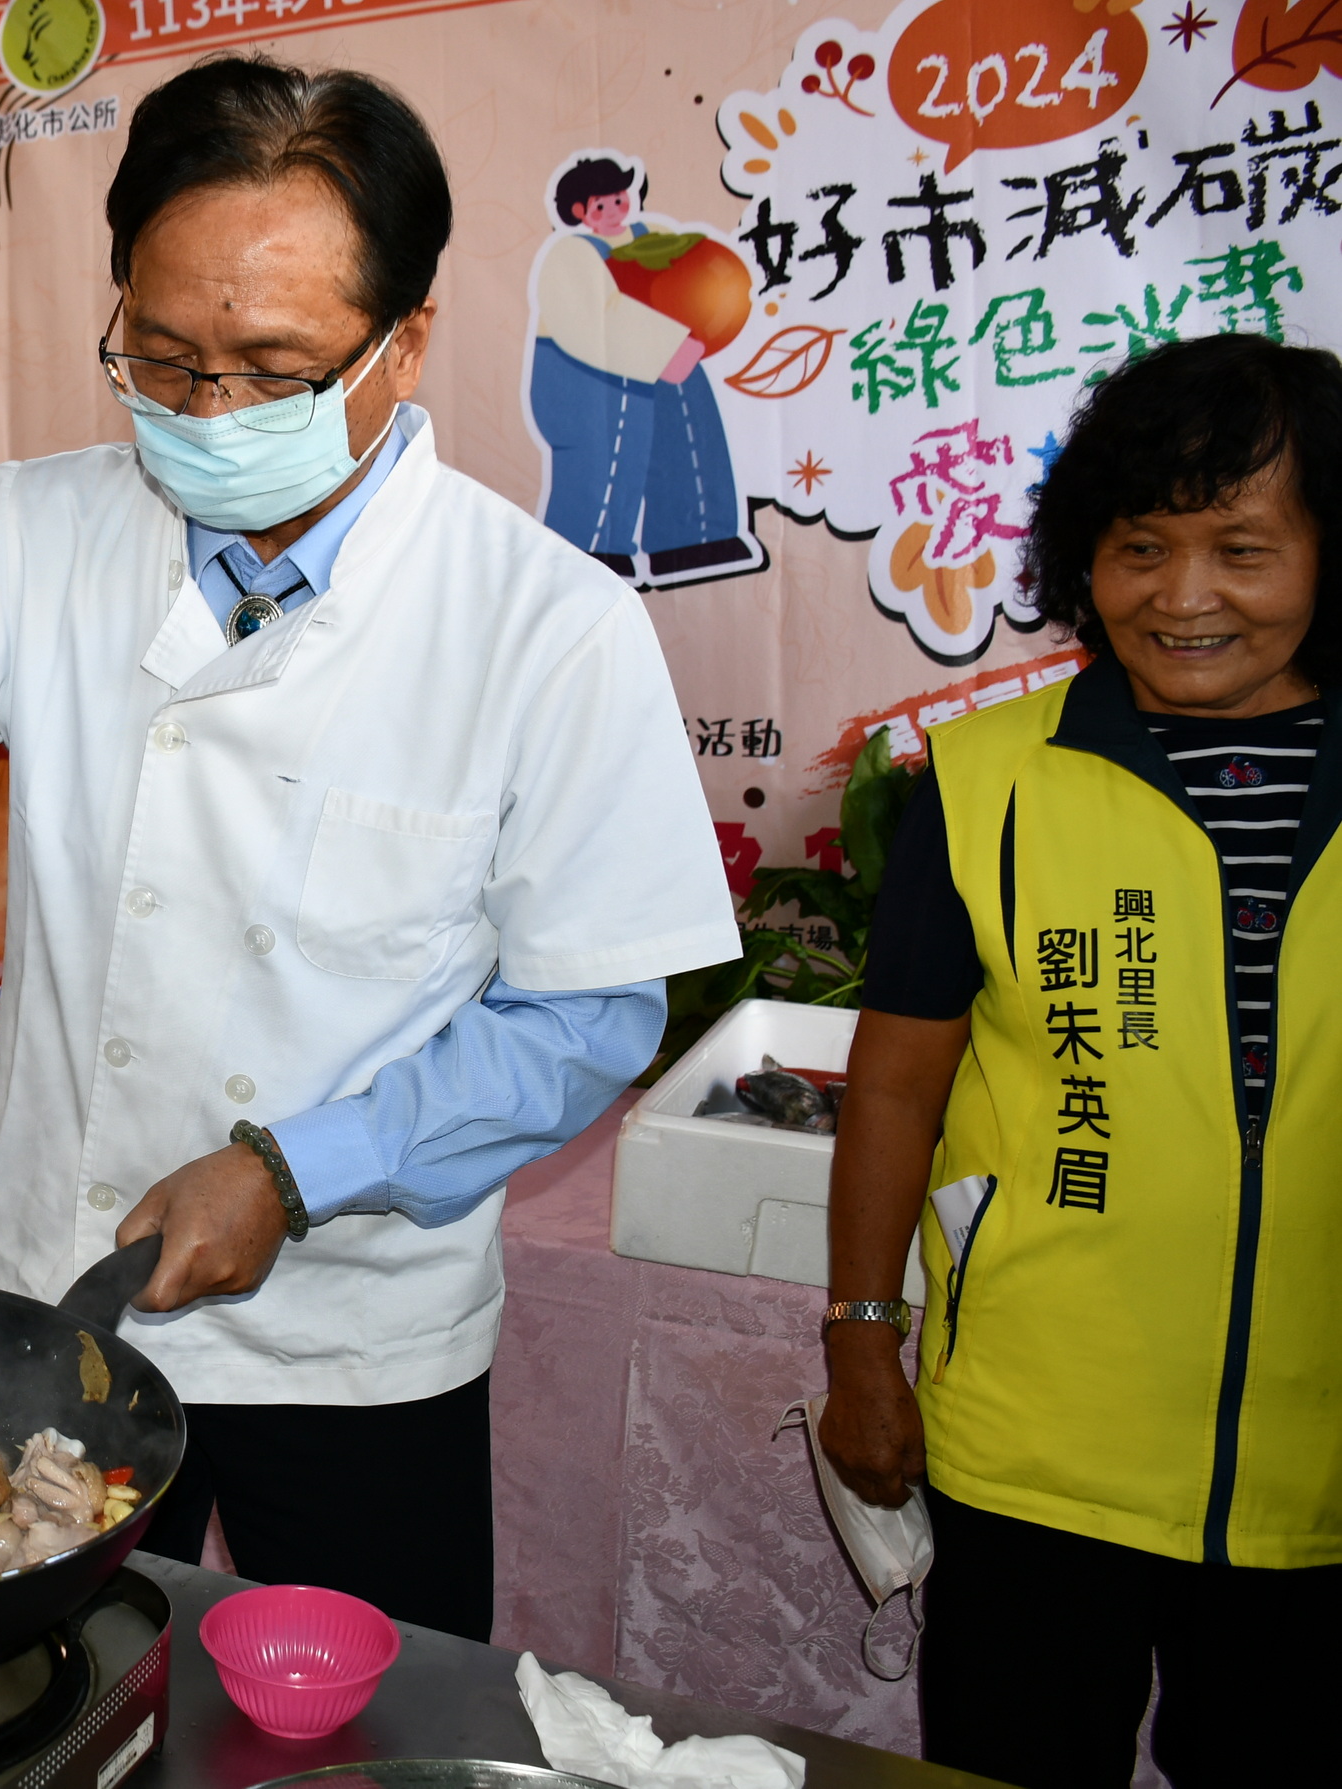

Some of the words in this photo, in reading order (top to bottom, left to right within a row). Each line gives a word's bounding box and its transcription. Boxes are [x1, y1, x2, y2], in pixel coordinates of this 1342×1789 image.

[915, 28, 1119, 126] 2024
[888, 417, 1032, 560] 愛
[683, 717, 782, 758] 活動
[1113, 888, 1160, 1051] 興北里長
[1036, 927, 1111, 1214] 劉朱英眉
